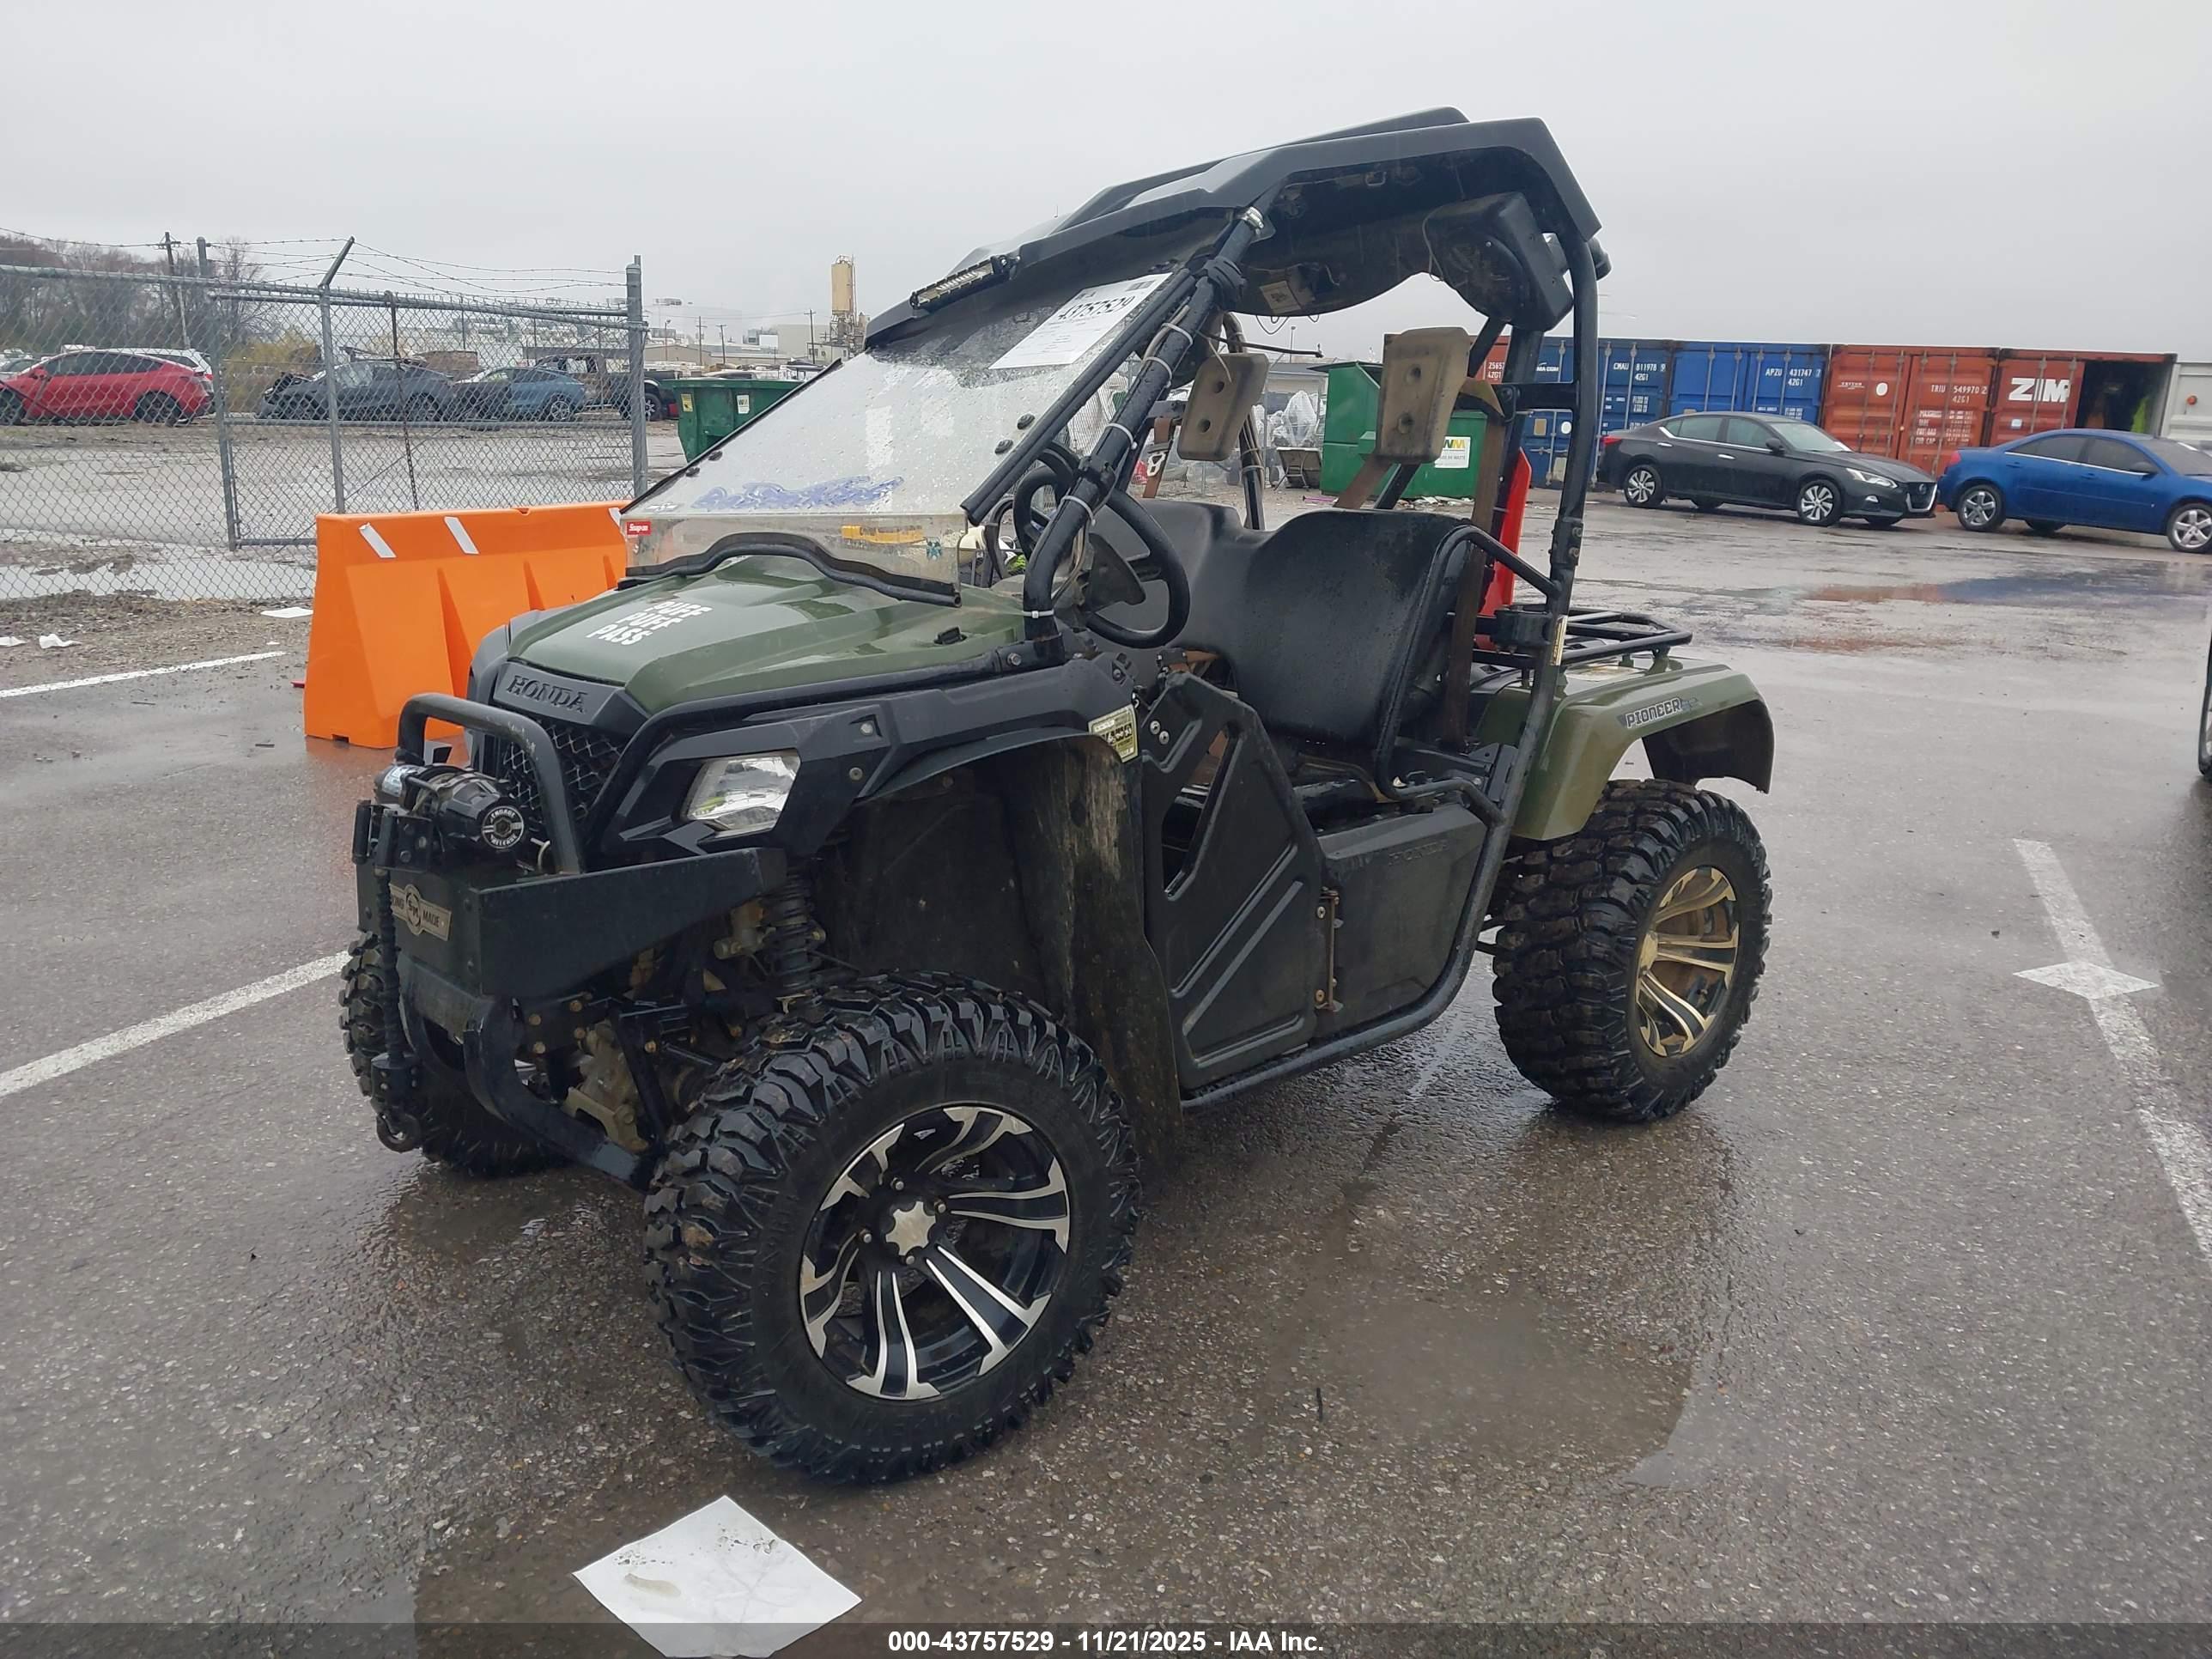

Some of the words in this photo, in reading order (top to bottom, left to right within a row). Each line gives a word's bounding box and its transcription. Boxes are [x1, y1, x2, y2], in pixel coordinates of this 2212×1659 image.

[1636, 363, 1657, 372] 811978
[1765, 368, 1783, 376] APZU
[1790, 368, 1813, 377] 431747
[1788, 378, 1803, 386] 42G1
[1953, 385, 1979, 394] 549970
[2008, 377, 2071, 403] ZIM
[615, 611, 684, 631] PUFF
[586, 623, 653, 646] PASS
[506, 674, 589, 714] HONDA
[1625, 697, 1682, 729] PIONEER
